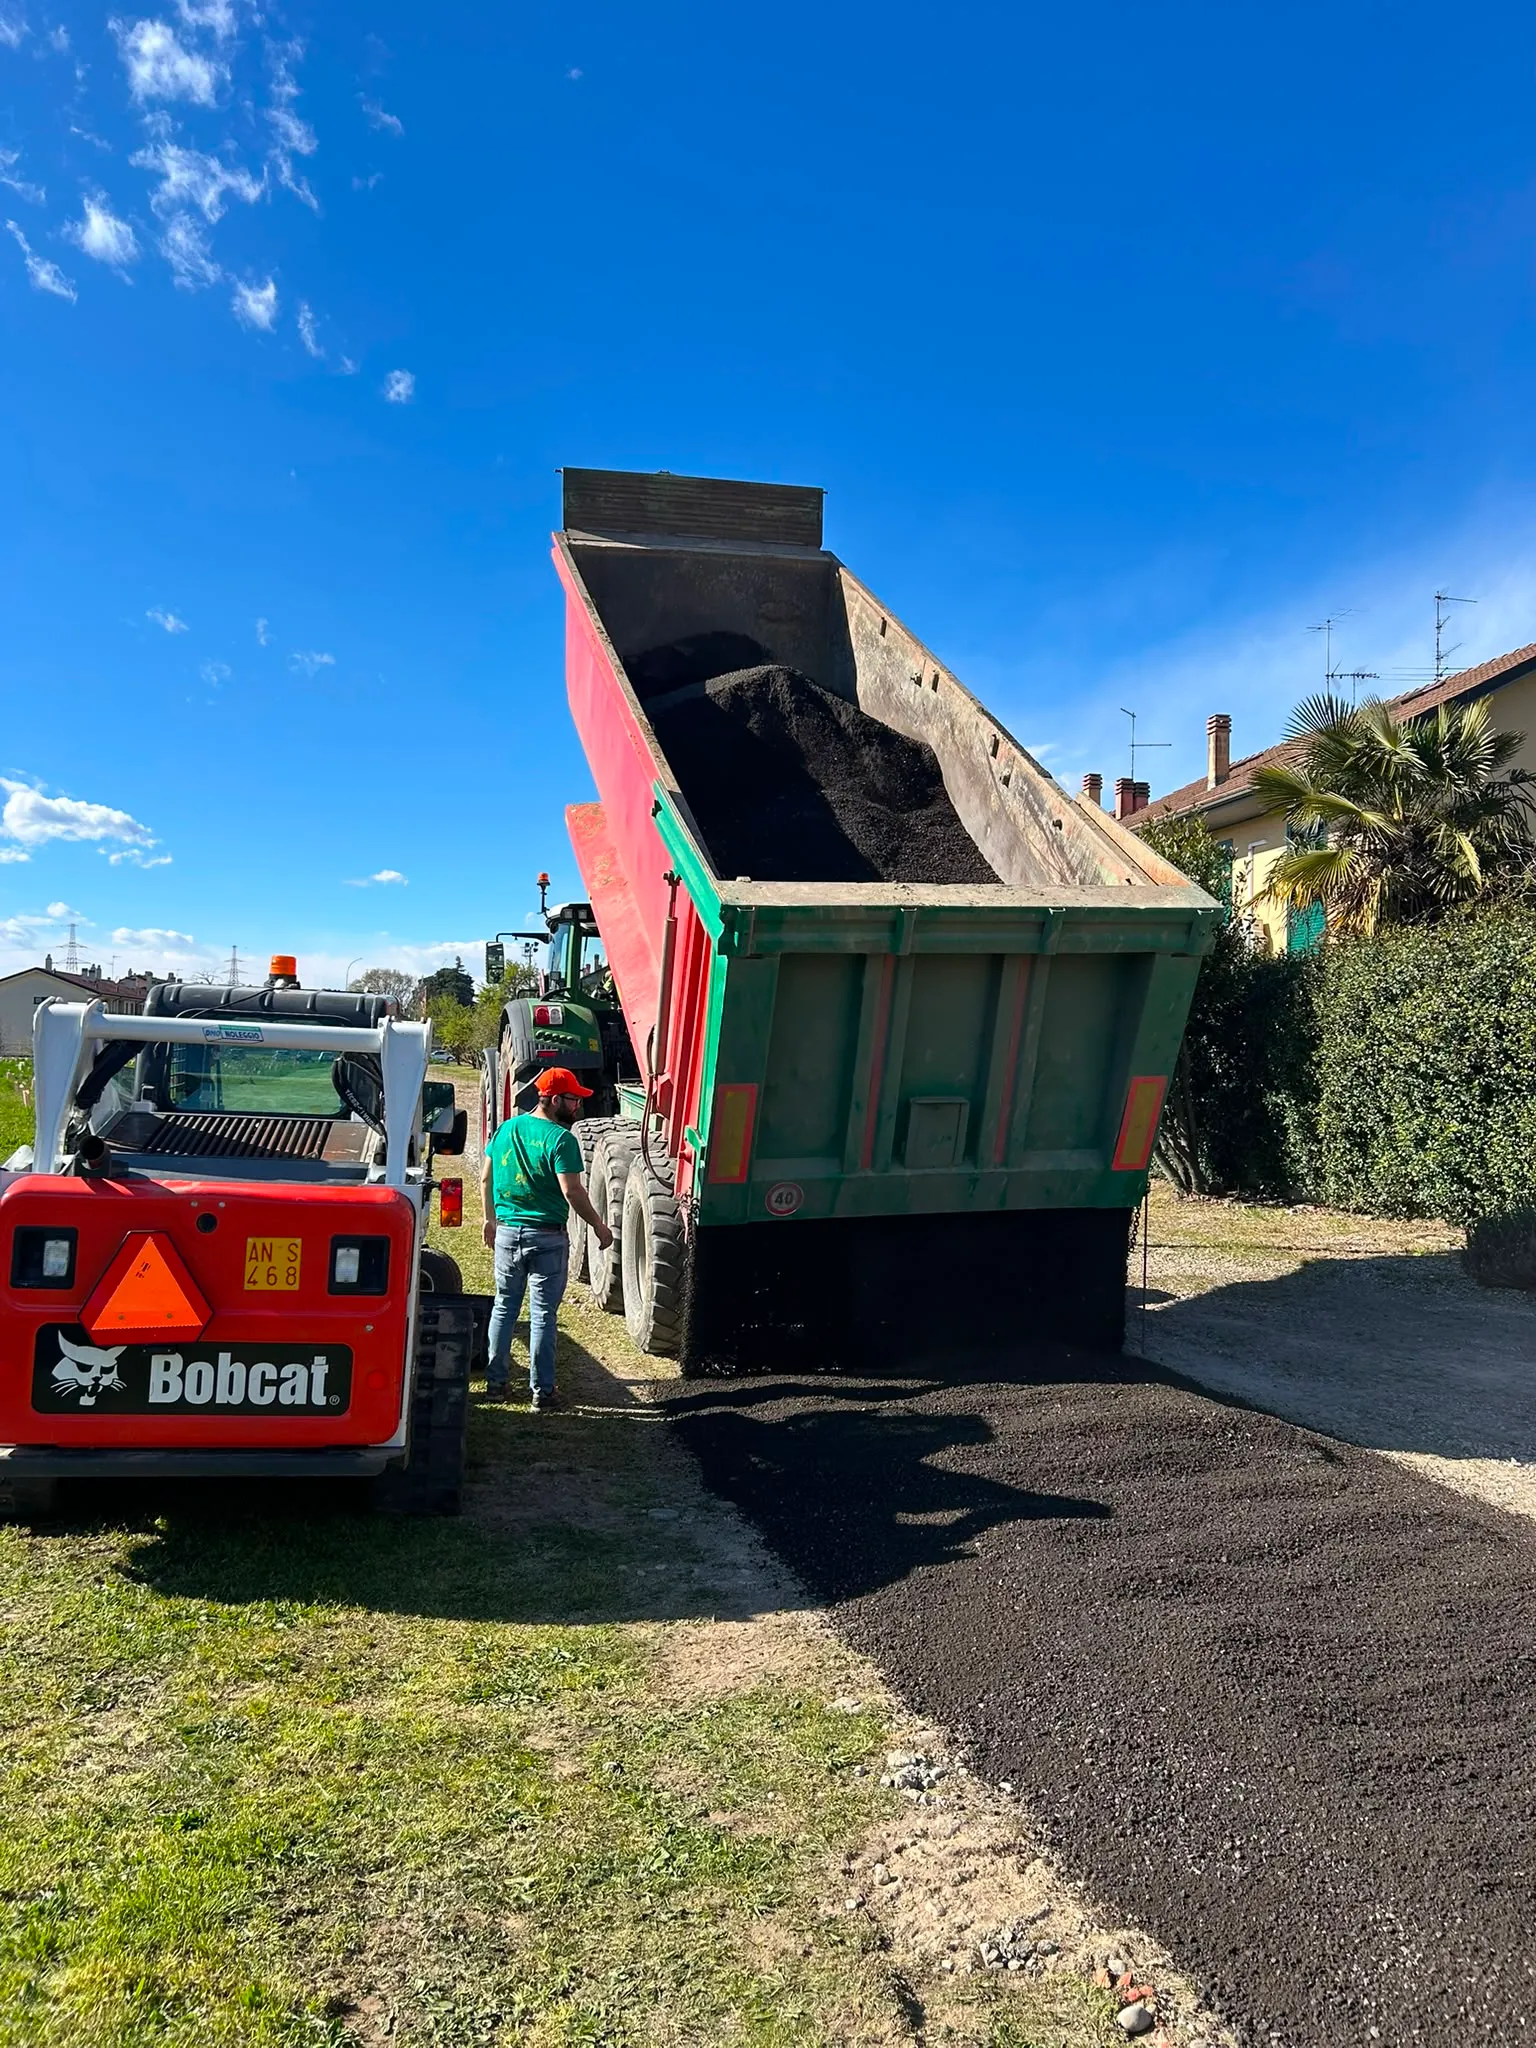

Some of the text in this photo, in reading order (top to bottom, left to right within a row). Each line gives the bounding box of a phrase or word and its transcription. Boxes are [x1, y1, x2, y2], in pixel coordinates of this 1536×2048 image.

[225, 1030, 260, 1039] NOLEGGIO
[774, 1191, 794, 1205] 40
[248, 1242, 299, 1263] AN S
[247, 1265, 297, 1286] 468
[148, 1352, 329, 1405] Bobcat
